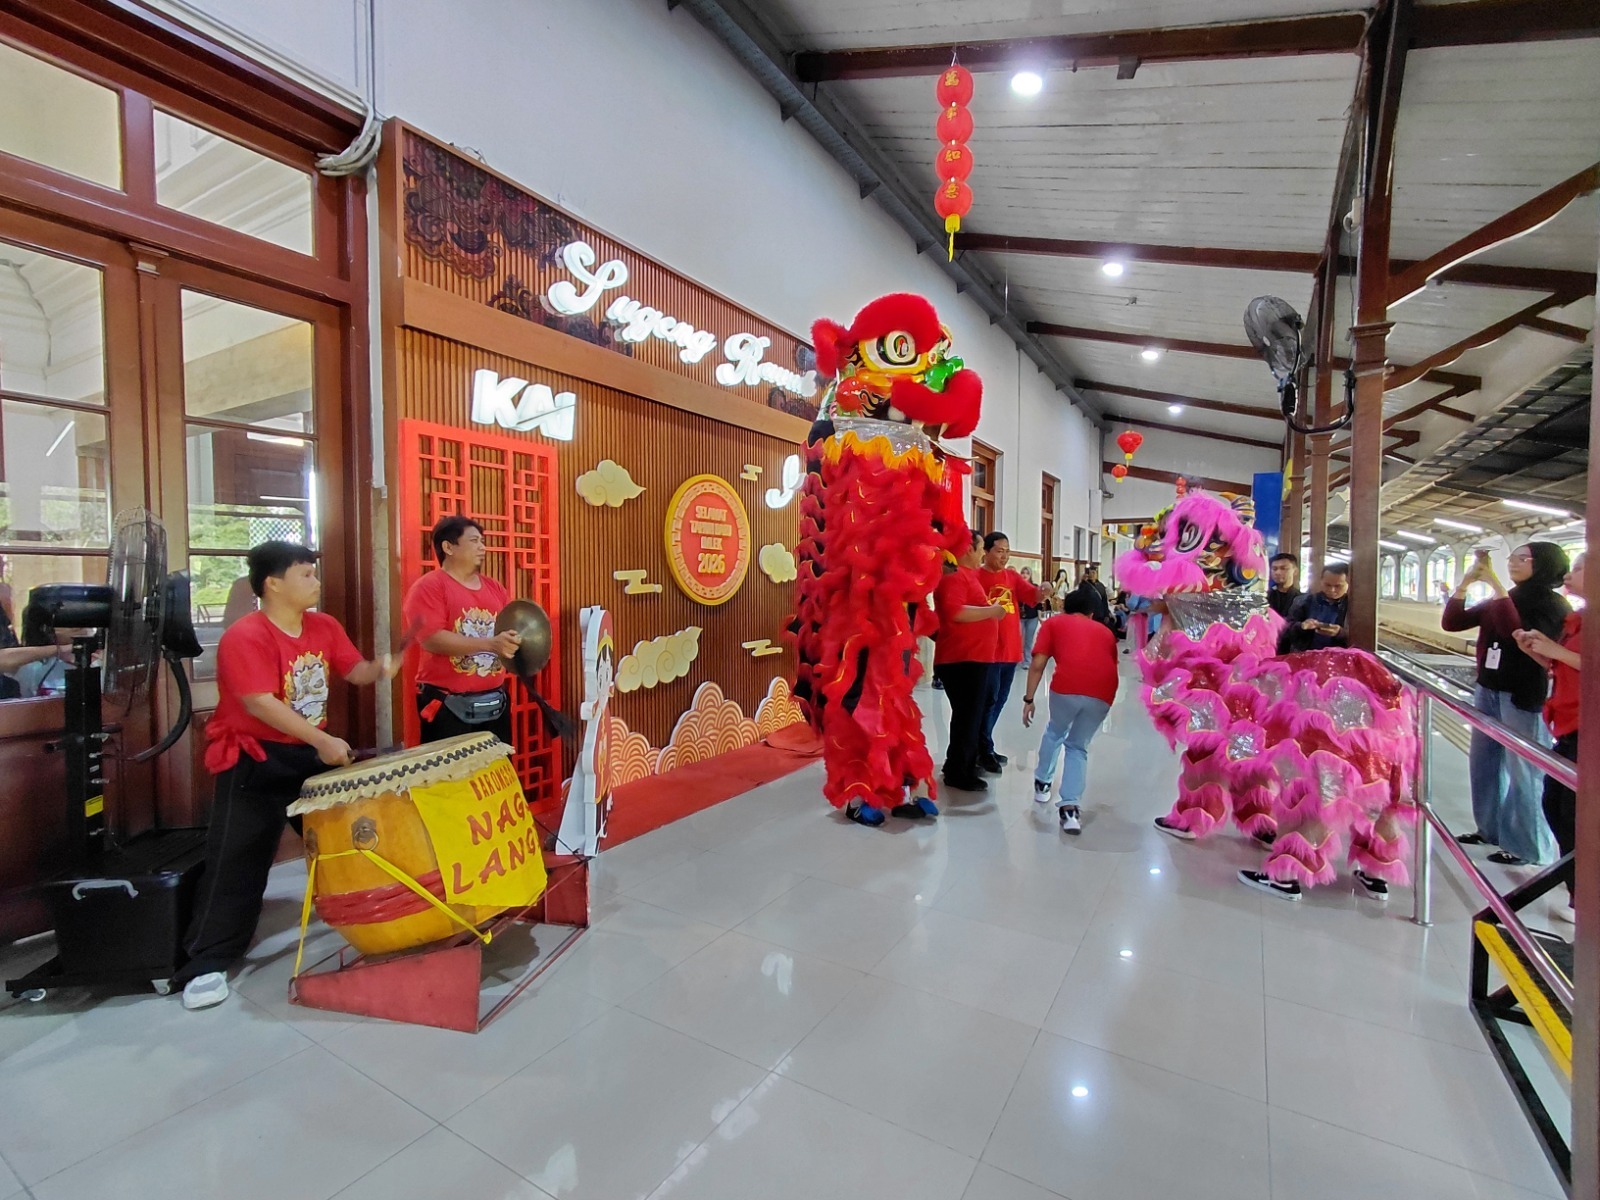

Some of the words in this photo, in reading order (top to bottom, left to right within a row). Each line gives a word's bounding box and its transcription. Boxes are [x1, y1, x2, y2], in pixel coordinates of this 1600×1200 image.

[547, 240, 717, 364] Sugeng
[471, 369, 576, 441] KAI
[695, 505, 728, 522] SELAMAT
[697, 552, 726, 574] 2026
[466, 792, 530, 846] NAG
[452, 827, 538, 895] LANG
